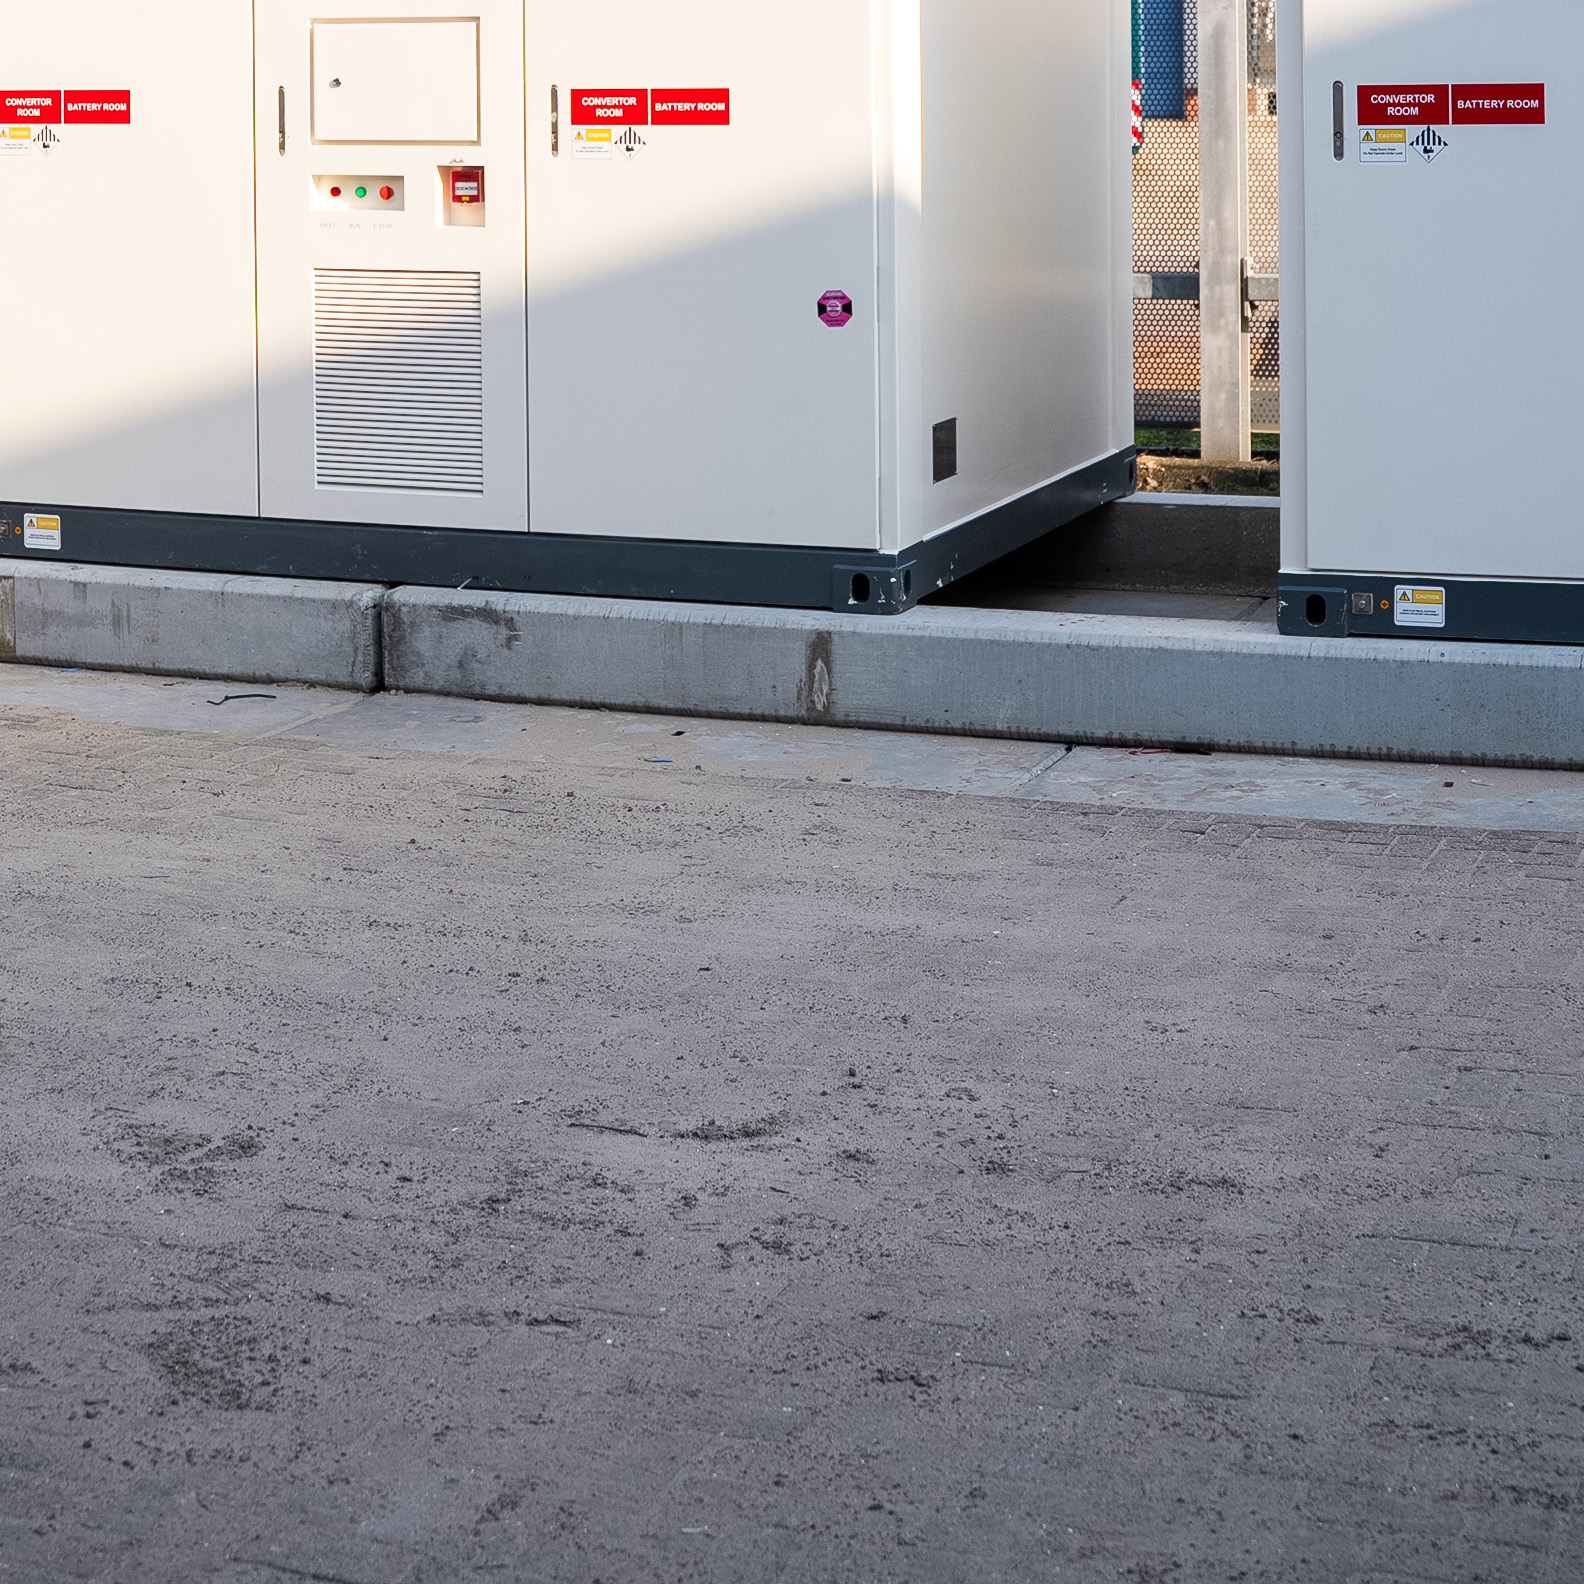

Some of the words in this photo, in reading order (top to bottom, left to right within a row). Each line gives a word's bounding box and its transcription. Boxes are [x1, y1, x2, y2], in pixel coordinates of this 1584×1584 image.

[5, 97, 52, 106] CONVERTOR
[581, 96, 637, 106] CONVERTOR
[1370, 94, 1435, 104] CONVERTOR
[67, 102, 102, 111] BATTERY
[103, 102, 127, 111] ROOM
[654, 102, 696, 111] BATTERY
[697, 102, 725, 111] ROOM
[1457, 99, 1504, 109] BATTERY
[1507, 99, 1539, 108] ROOM
[16, 108, 41, 116] ROOM
[595, 108, 623, 117] ROOM
[1387, 106, 1419, 116] ROOM
